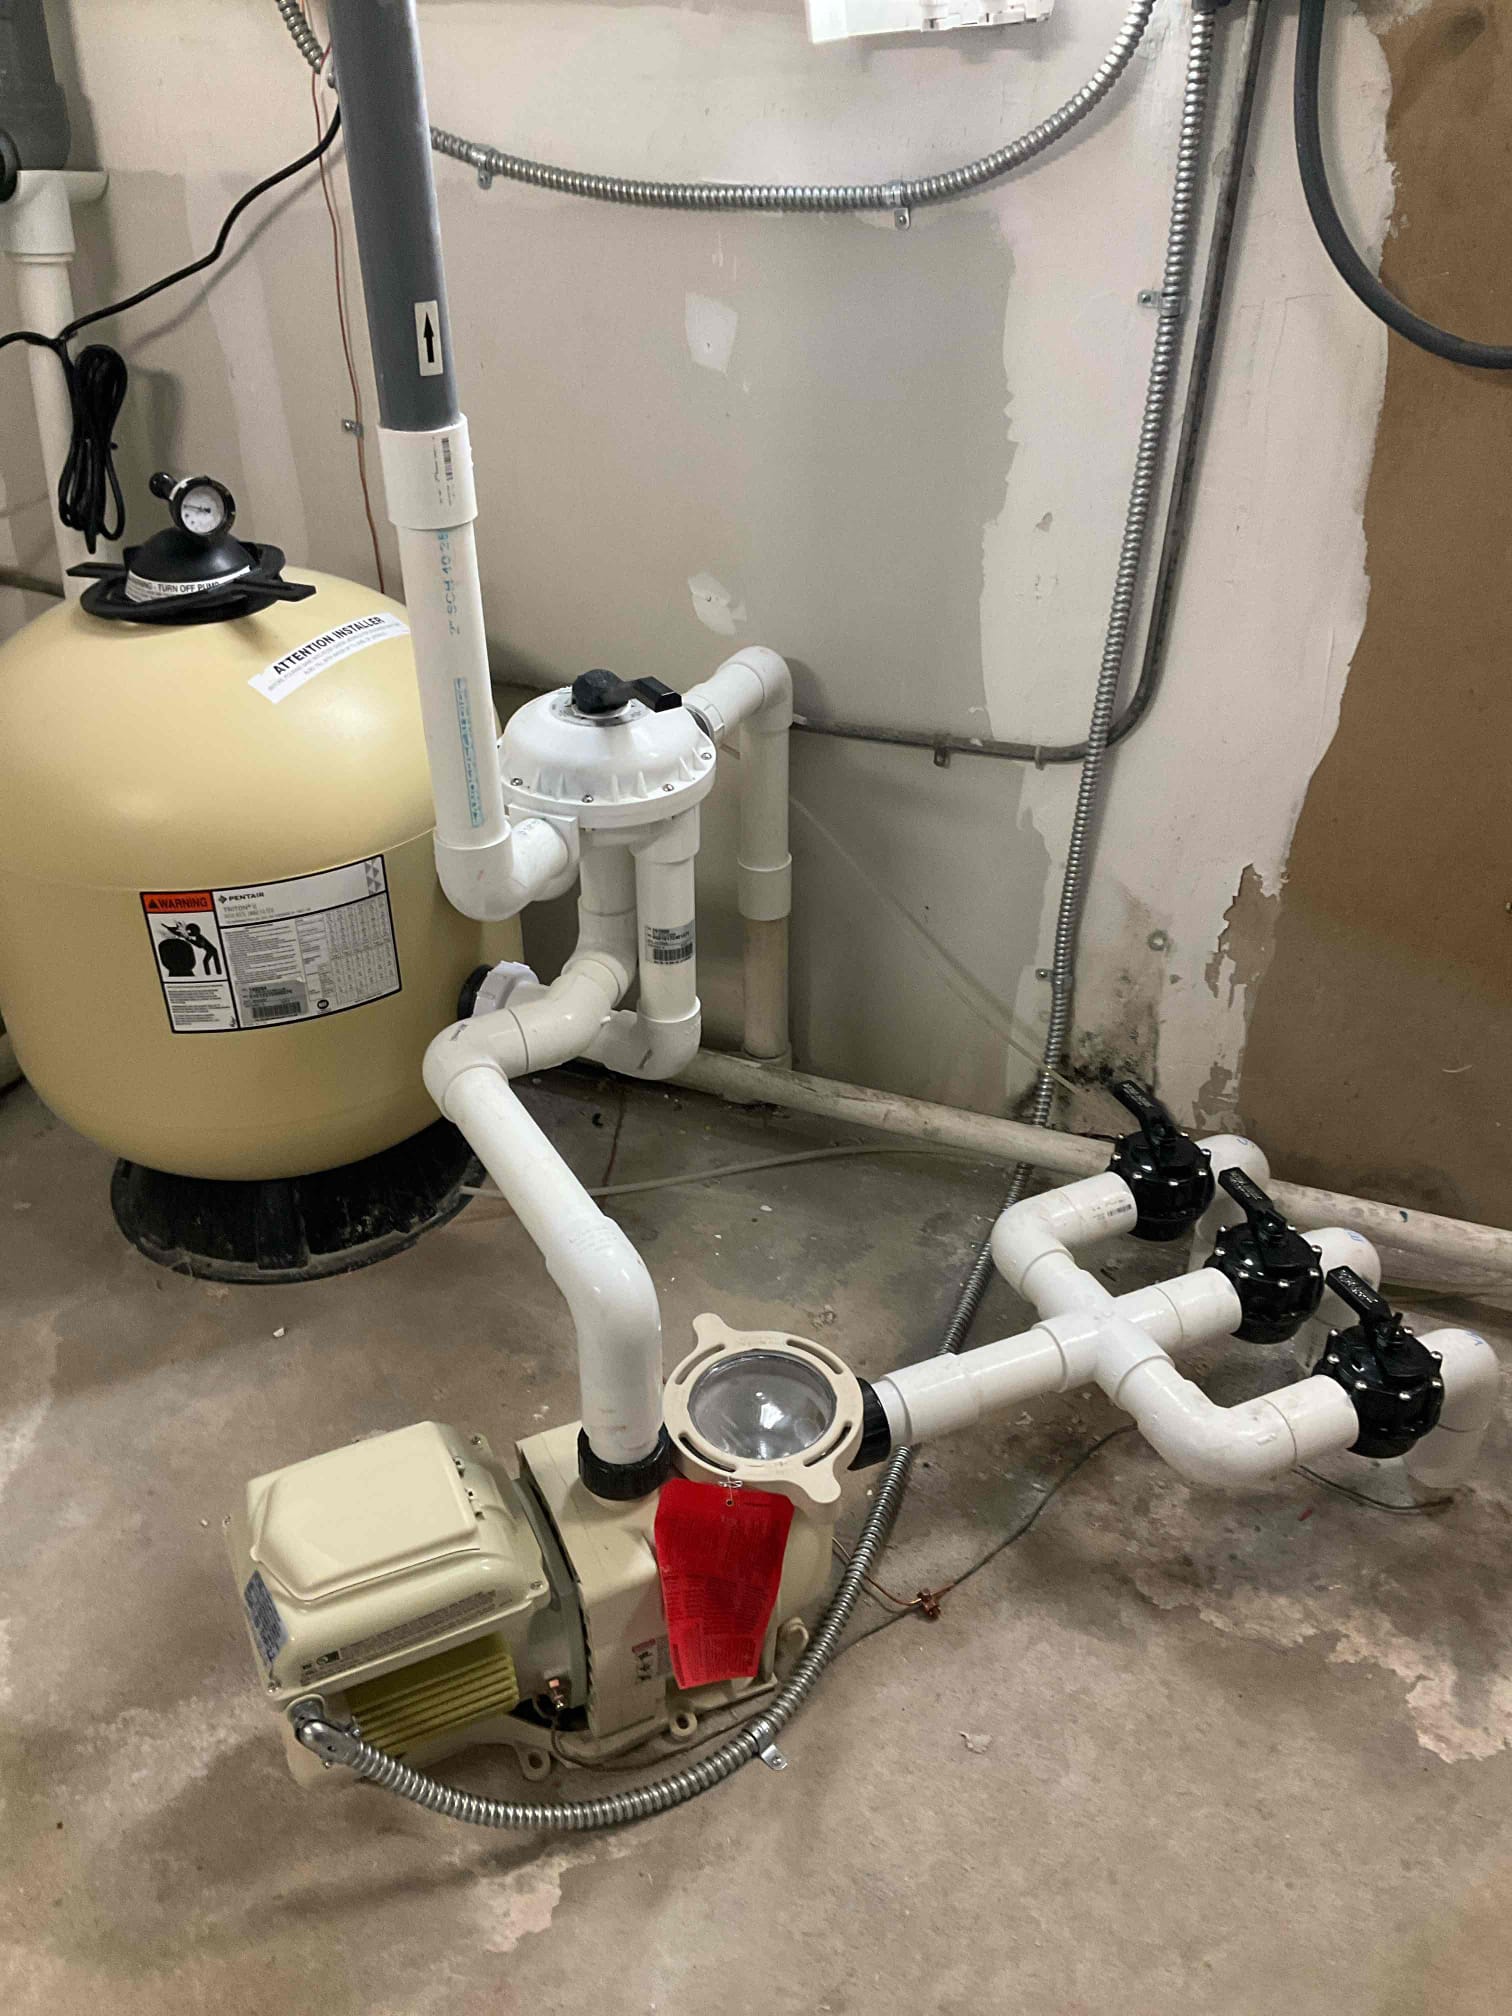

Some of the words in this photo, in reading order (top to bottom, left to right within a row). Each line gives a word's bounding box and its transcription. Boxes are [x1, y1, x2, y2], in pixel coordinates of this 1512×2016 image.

[440, 555, 452, 575] 40
[157, 583, 178, 593] TURN
[179, 584, 195, 593] OFF
[443, 578, 457, 615] SCH
[273, 634, 335, 675] ATTENTION
[332, 616, 385, 639] INSTALLER
[158, 896, 209, 909] WARNING
[228, 891, 265, 902] PENTAIR
